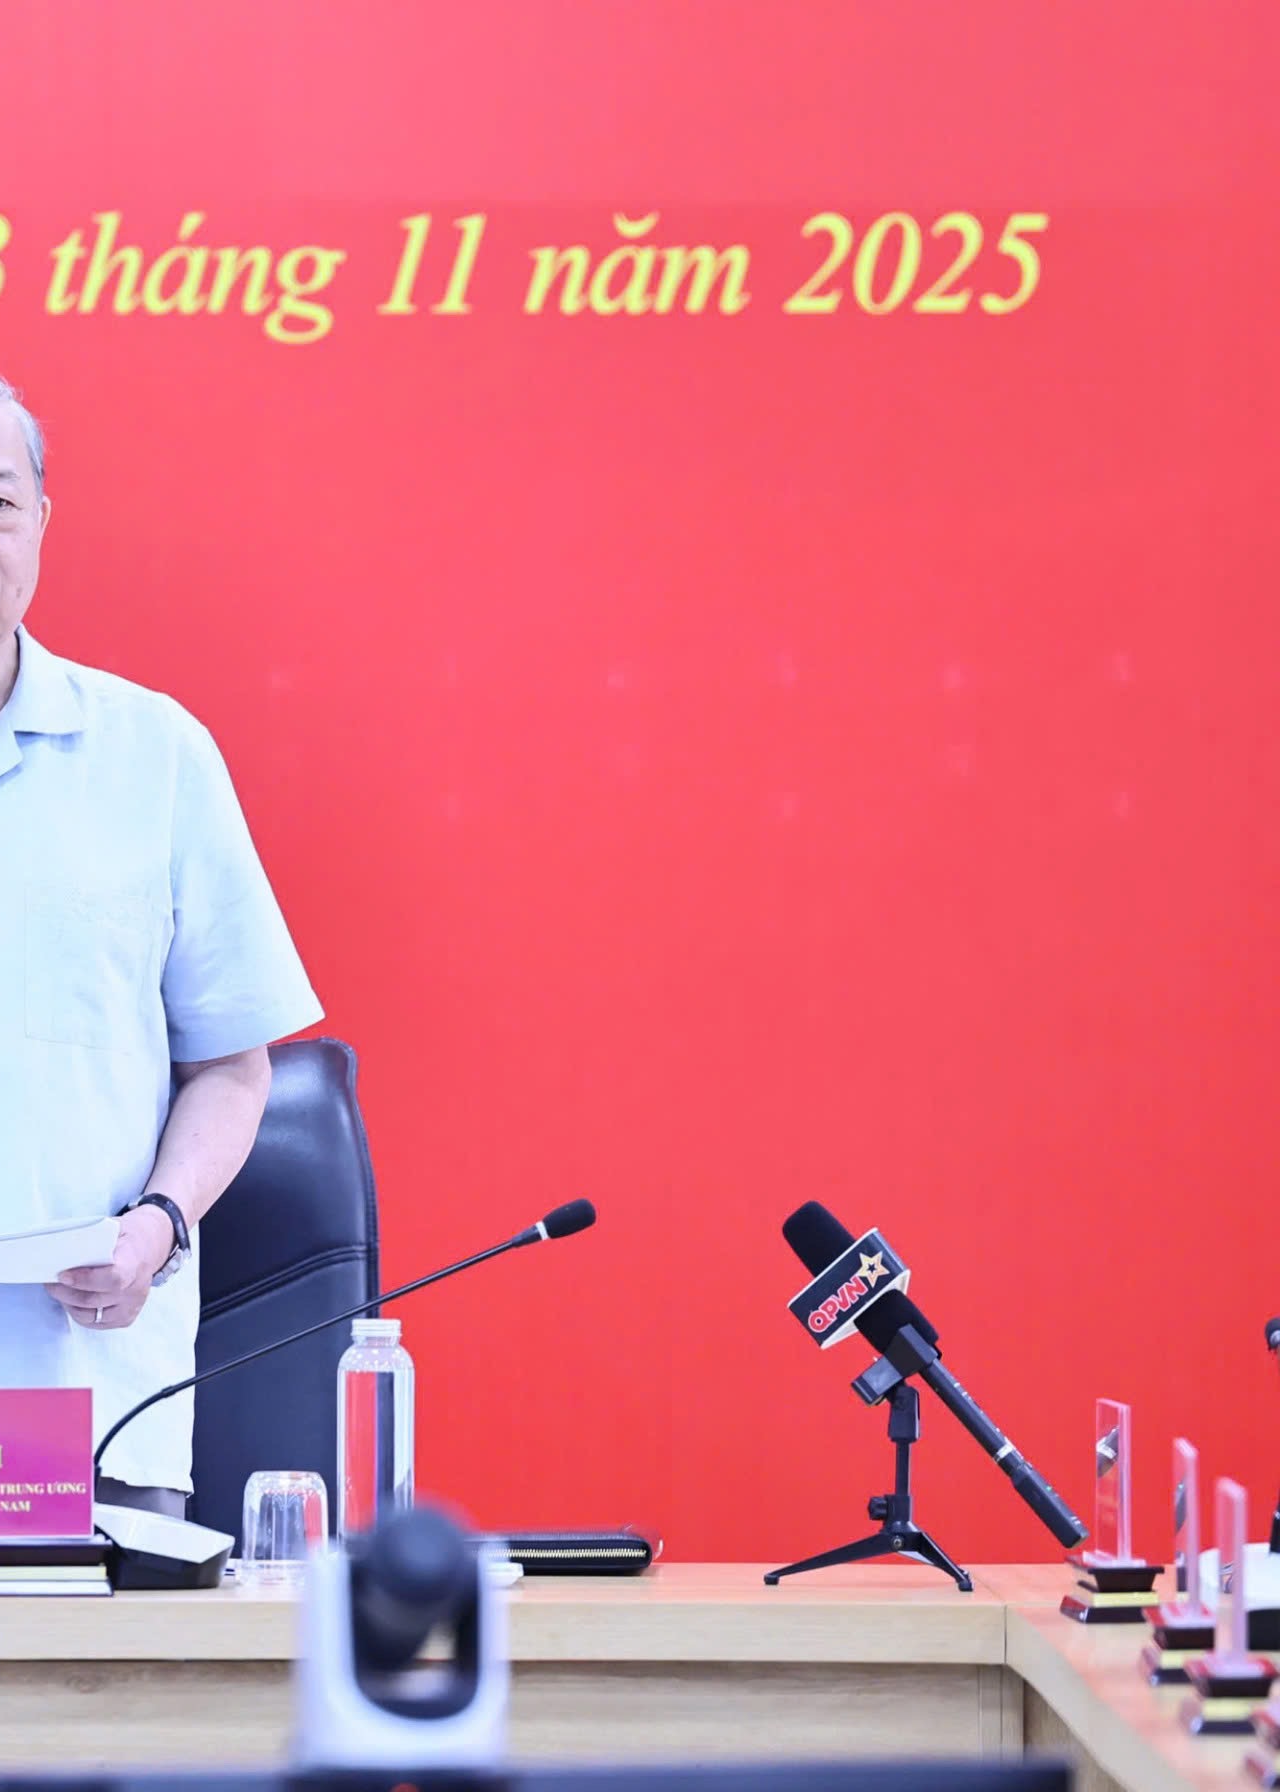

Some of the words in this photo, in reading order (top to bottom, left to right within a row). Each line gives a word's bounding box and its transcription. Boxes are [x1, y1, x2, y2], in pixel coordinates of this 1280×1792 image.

[45, 212, 345, 344] tháng
[379, 214, 487, 315] 11
[524, 214, 750, 315] năm
[783, 211, 1047, 315] 2025
[808, 1274, 869, 1333] QPVN
[0, 1500, 32, 1512] NAM
[46, 1481, 87, 1495] ƯƠNG
